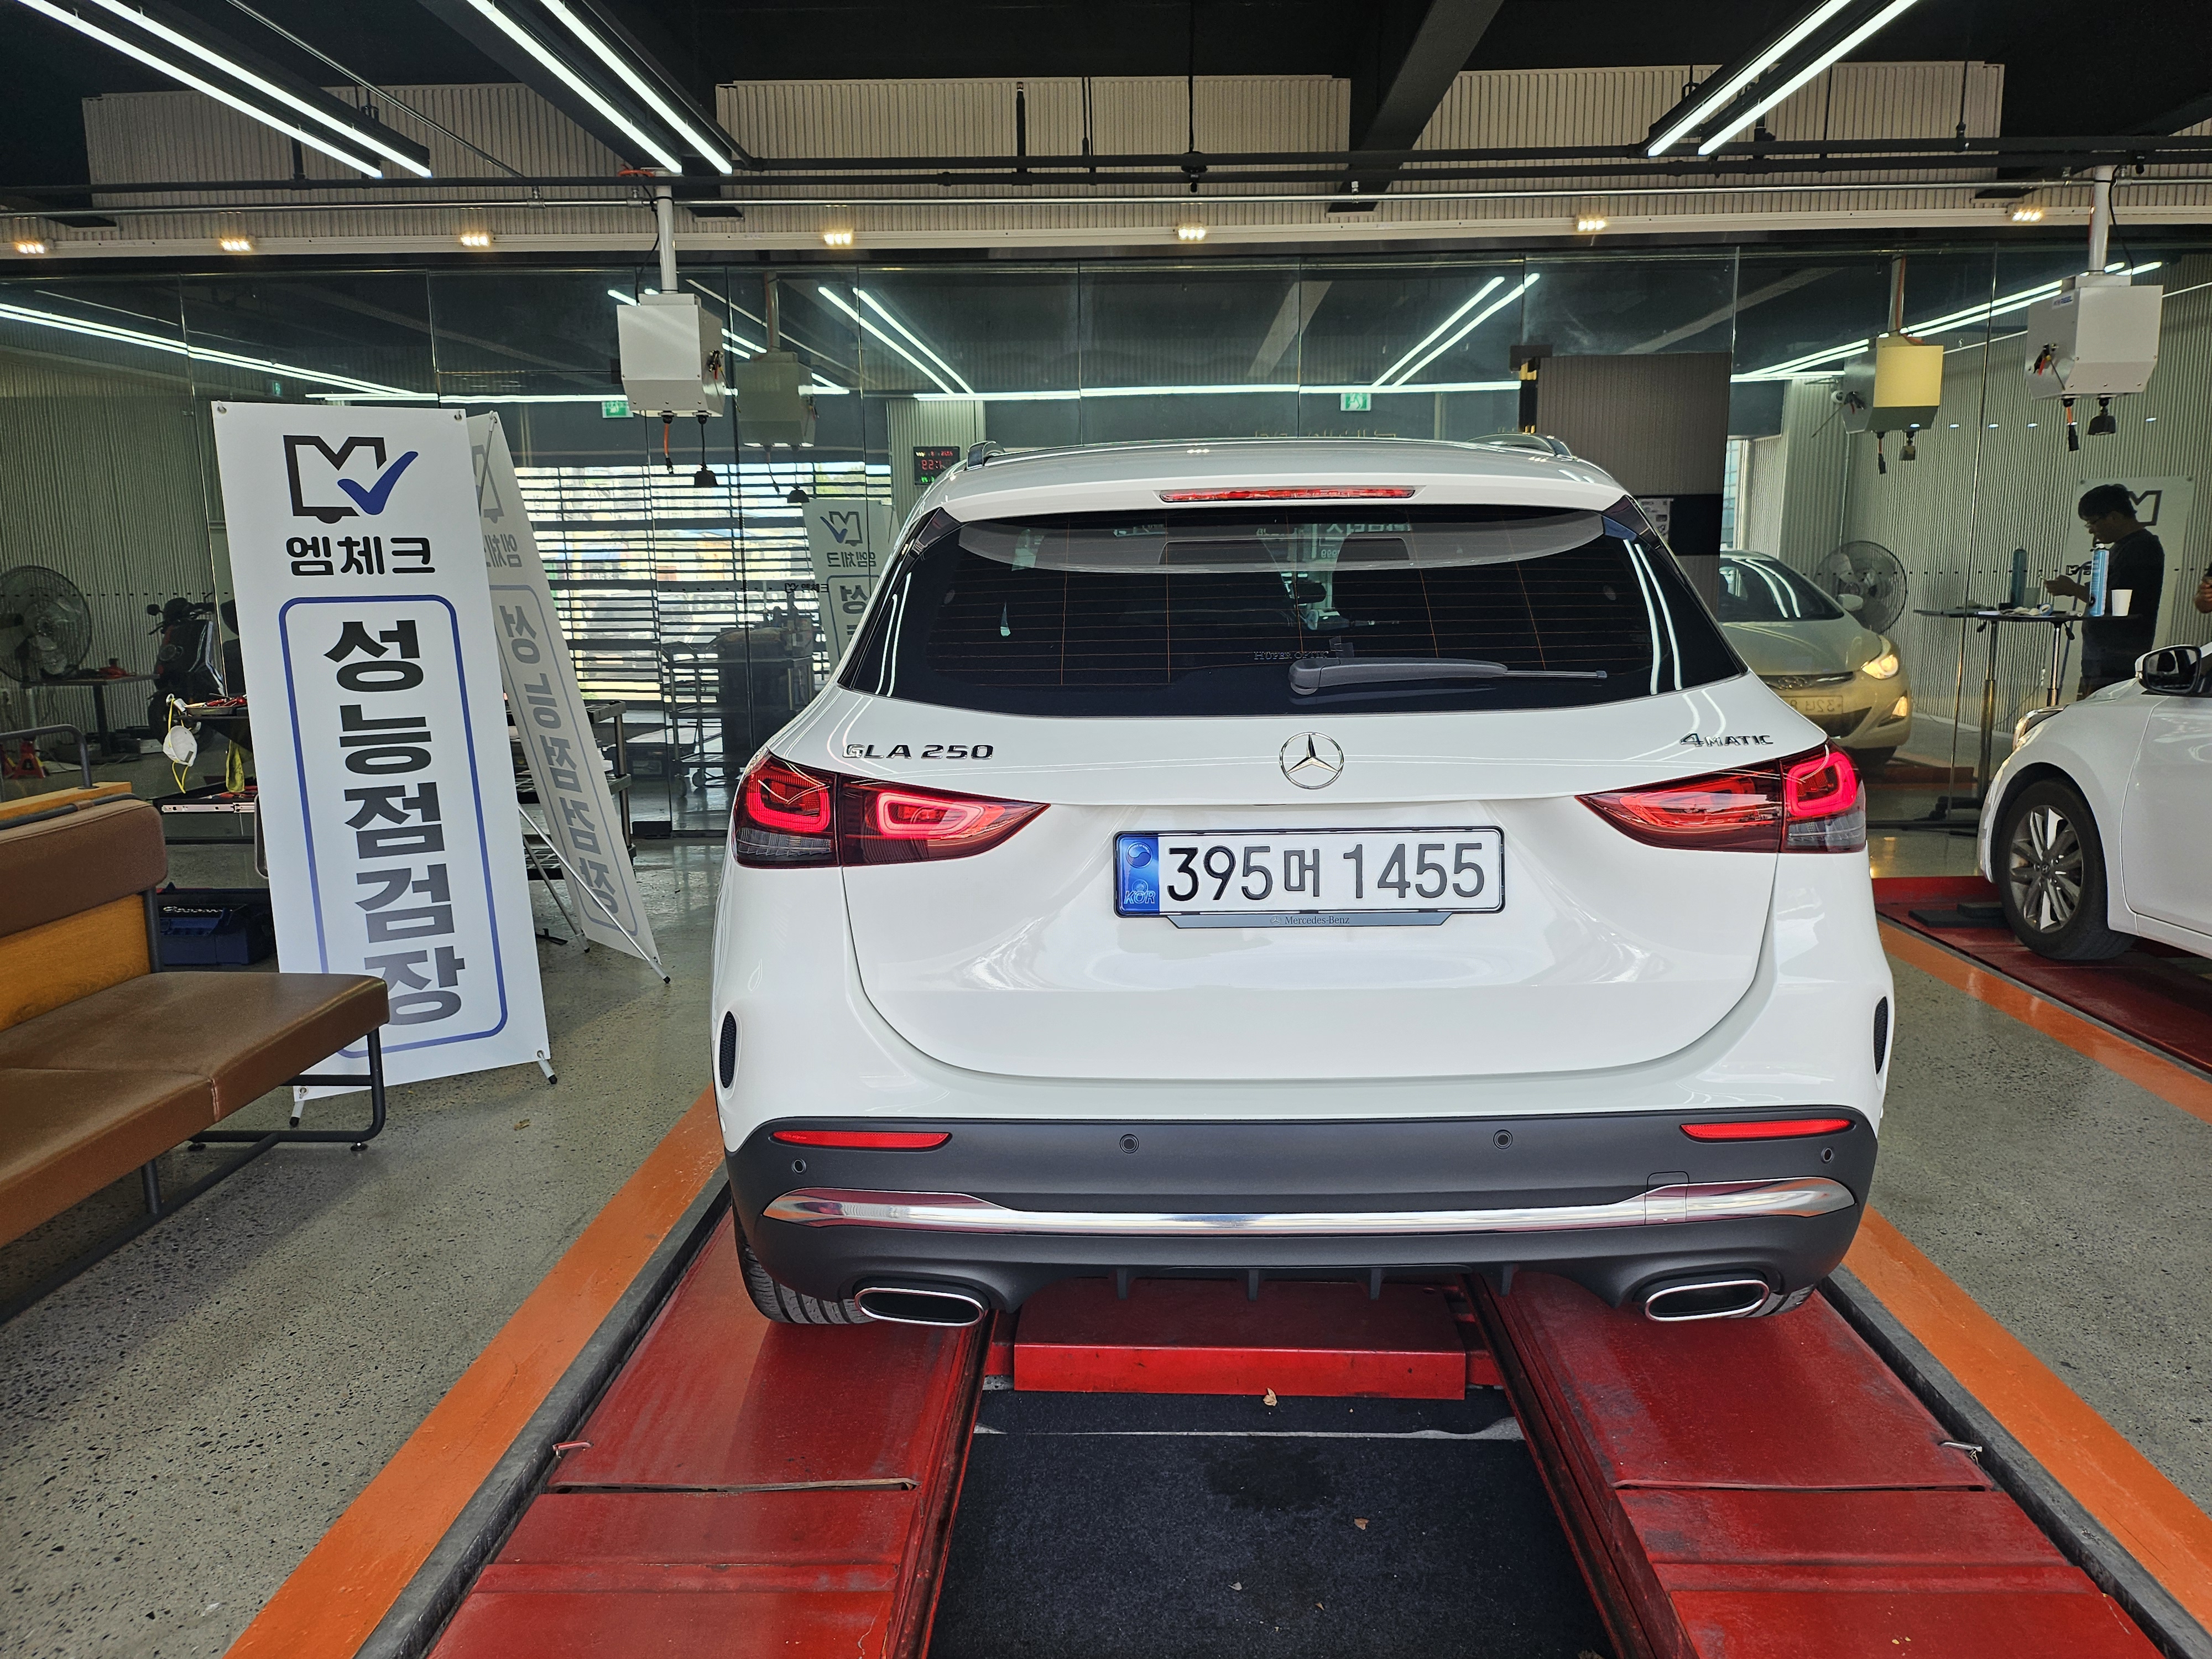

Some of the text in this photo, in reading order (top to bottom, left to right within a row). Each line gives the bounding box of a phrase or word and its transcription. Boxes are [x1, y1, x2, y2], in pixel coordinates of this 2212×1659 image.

[286, 536, 436, 576] 엠체크
[1680, 733, 1774, 747] 4MATIC
[842, 743, 994, 760] GLA 250
[324, 619, 466, 1026] 성능점검장
[1167, 843, 1485, 901] 395머 1455
[1123, 890, 1156, 904] KOR
[1284, 915, 1350, 925] Mercedes-Benz
